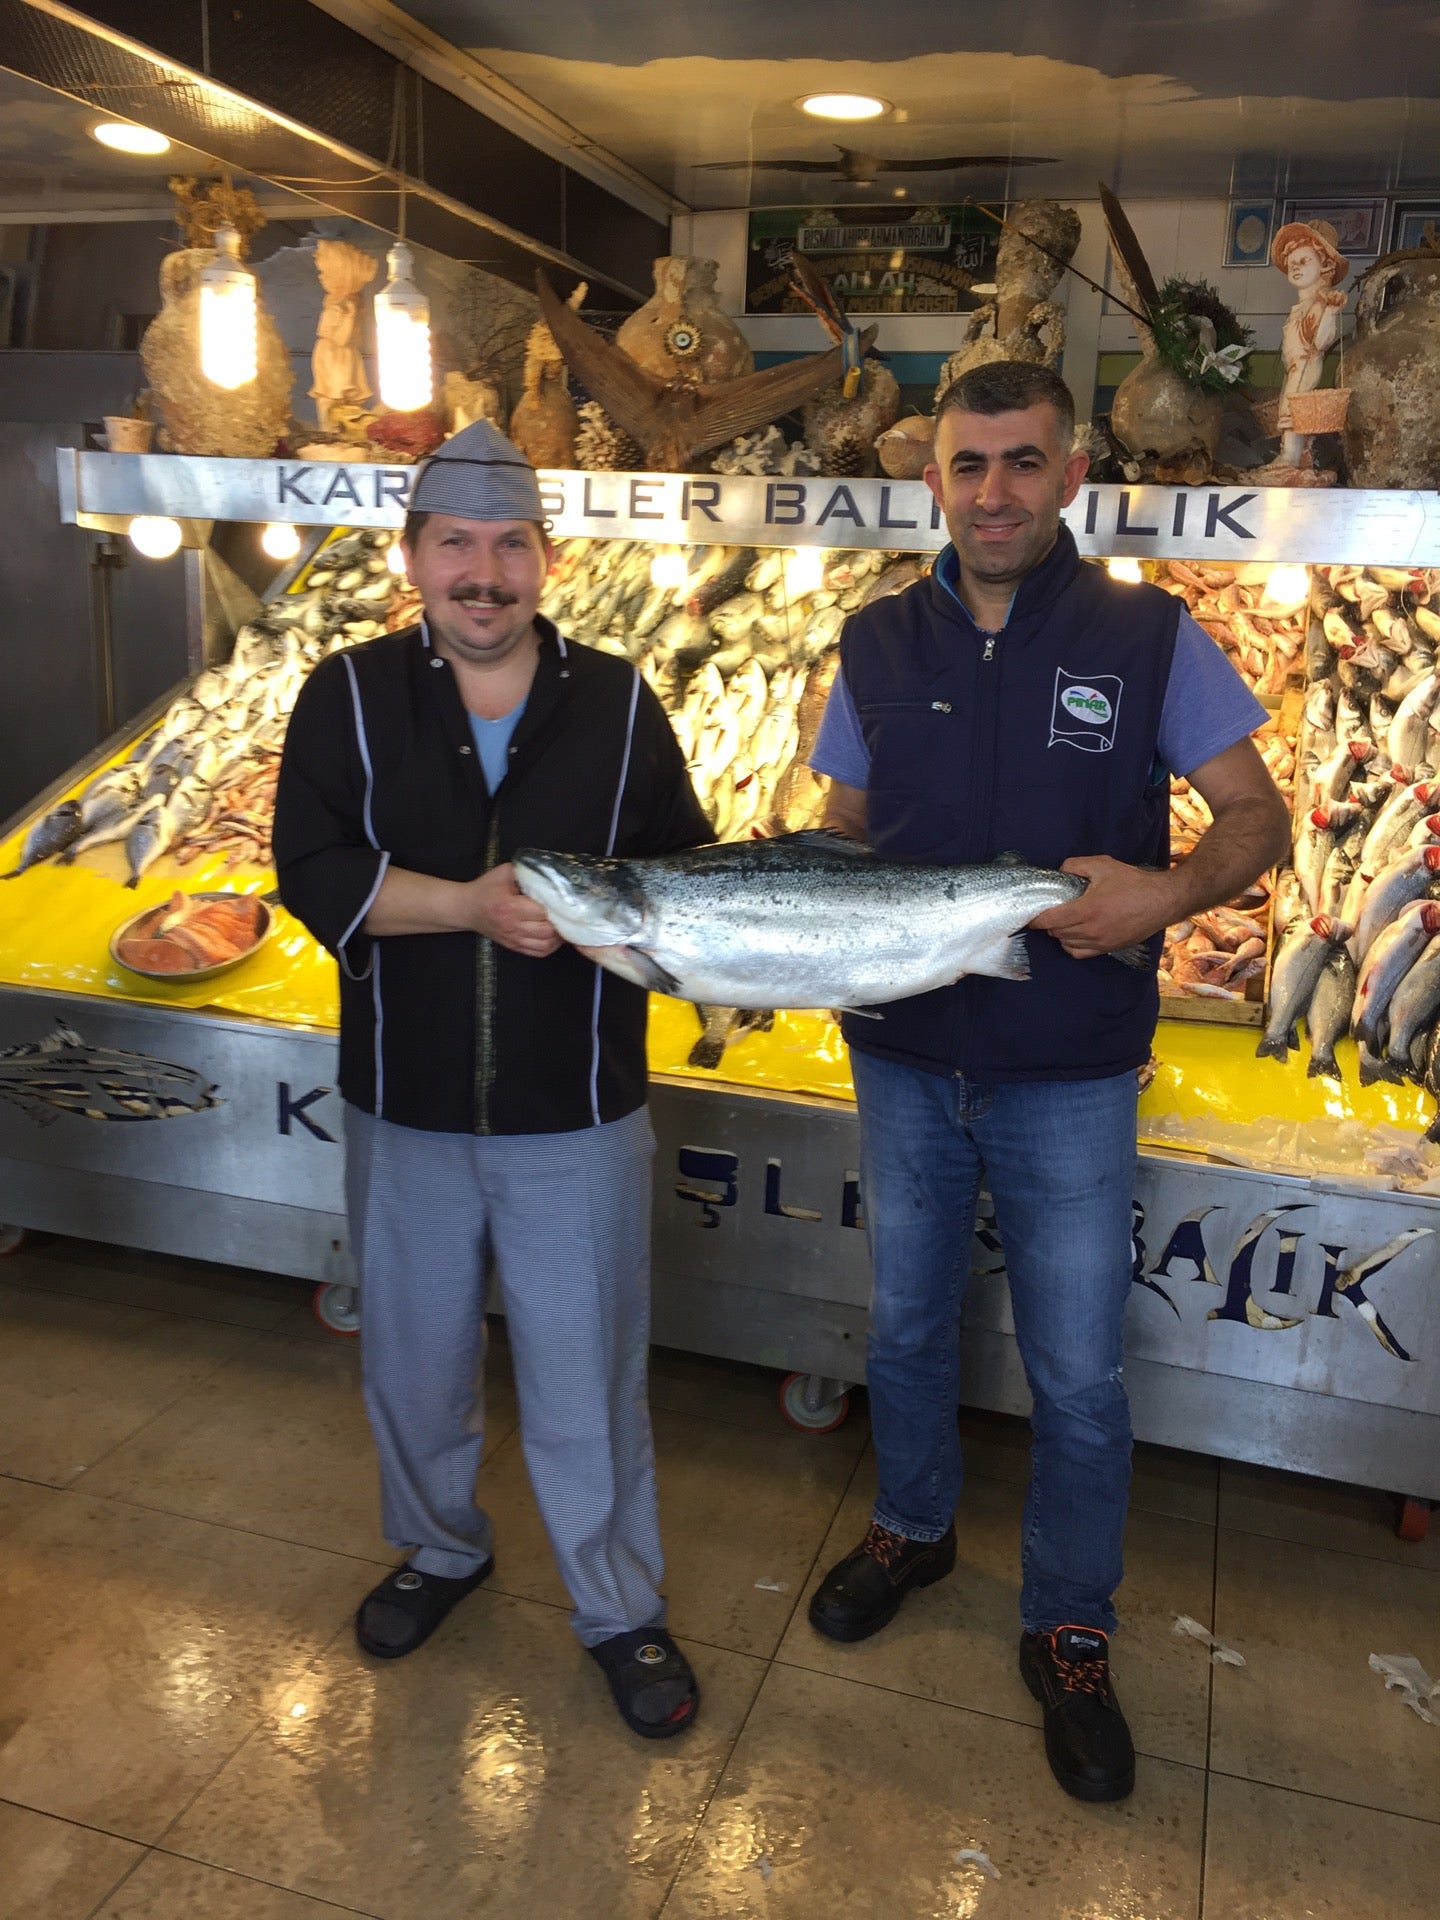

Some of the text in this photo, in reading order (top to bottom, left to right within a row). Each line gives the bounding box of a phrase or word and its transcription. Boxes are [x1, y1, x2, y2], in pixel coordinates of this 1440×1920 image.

[833, 270, 916, 296] ALLAH
[276, 465, 1260, 539] KARŞLER BALIILIK
